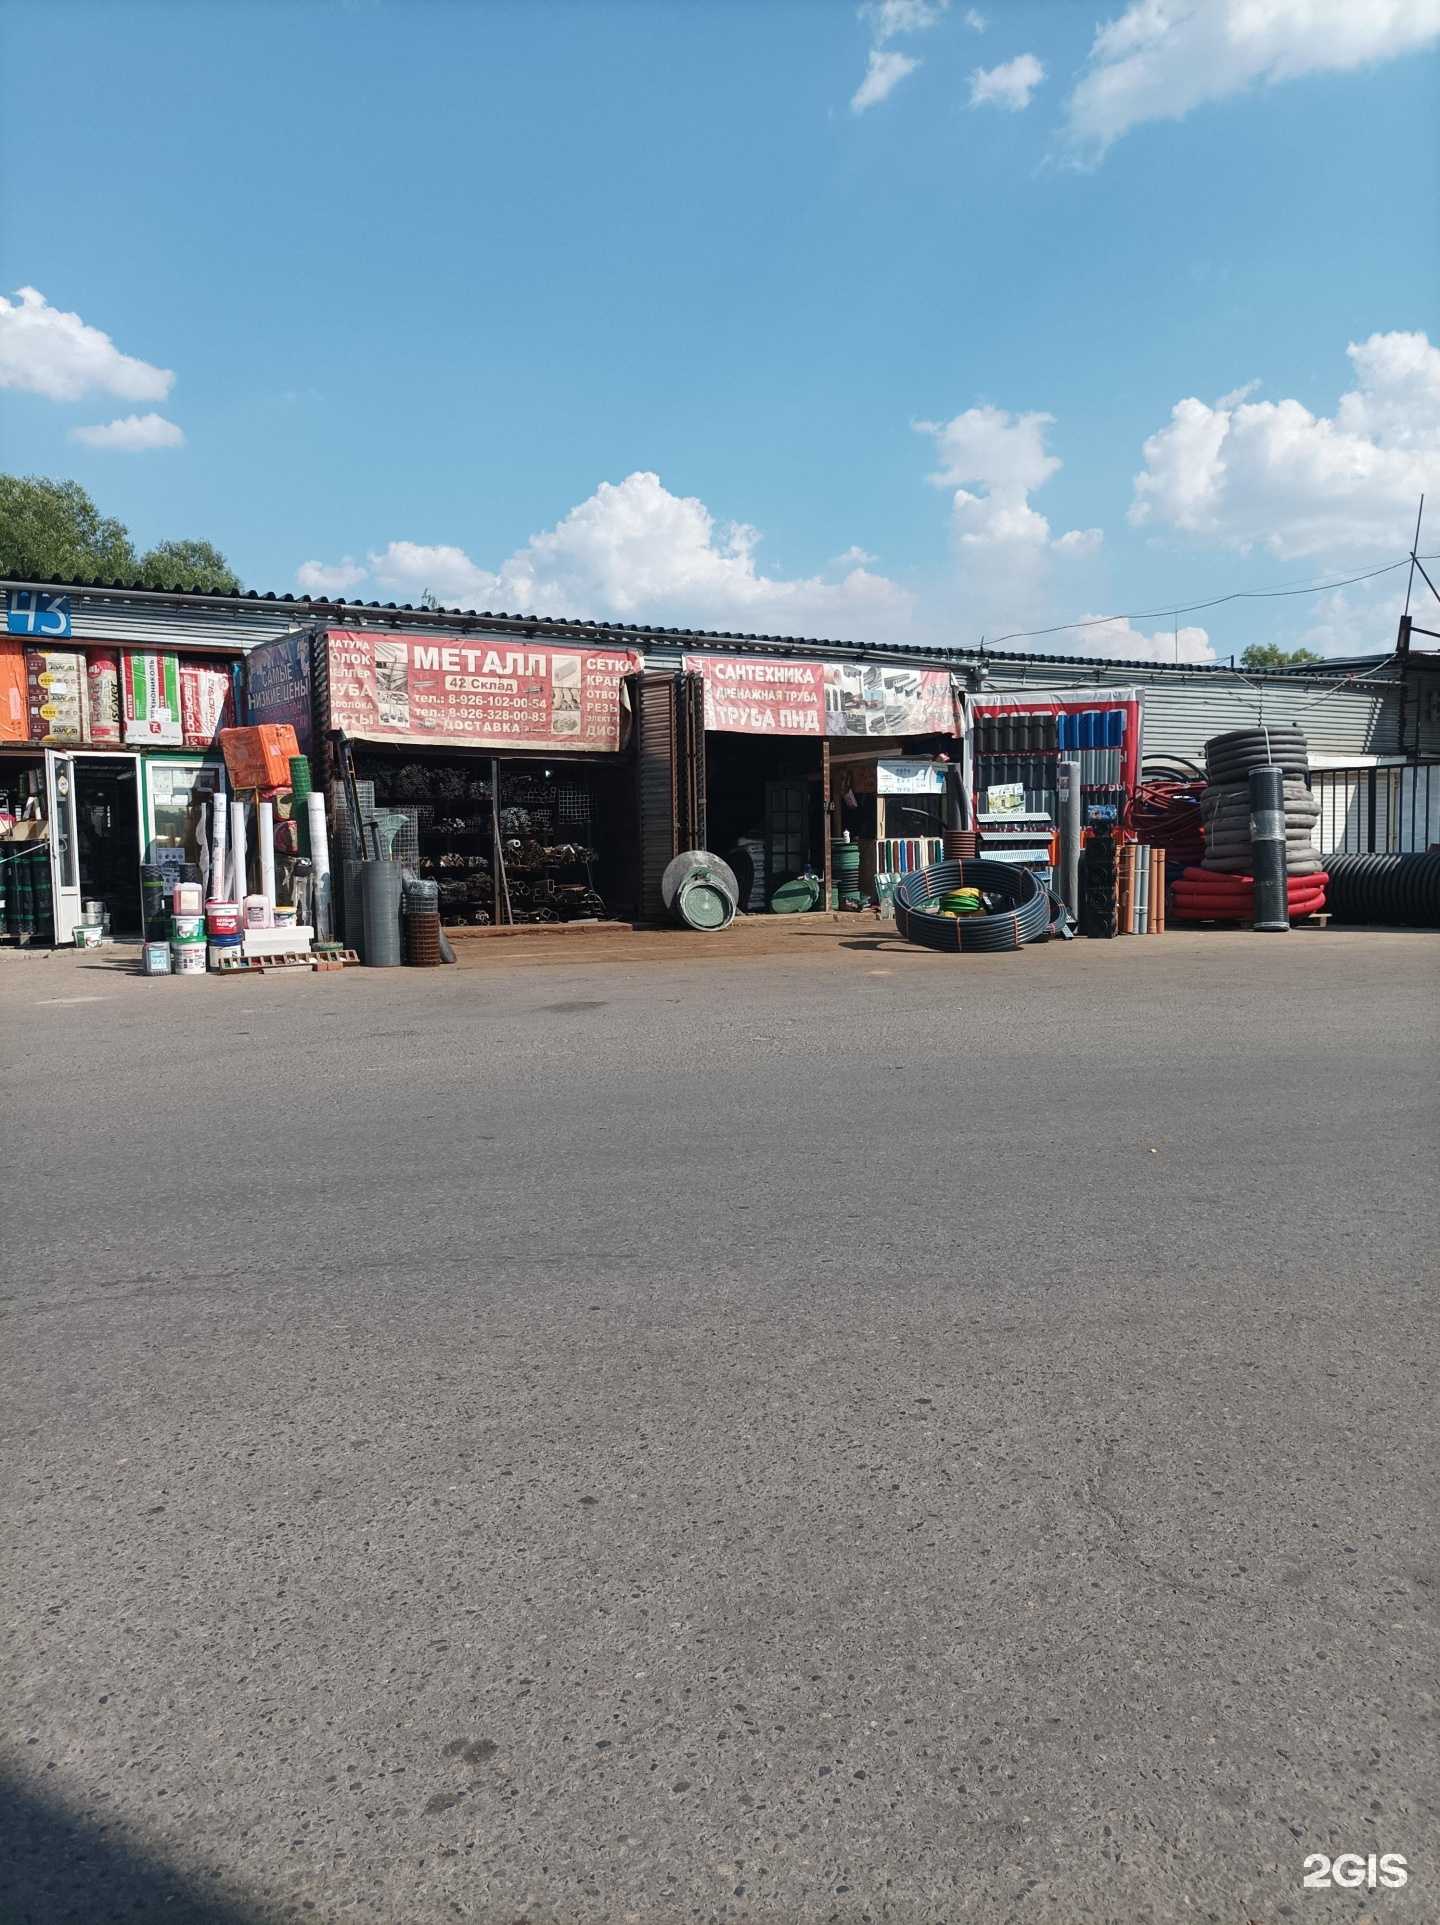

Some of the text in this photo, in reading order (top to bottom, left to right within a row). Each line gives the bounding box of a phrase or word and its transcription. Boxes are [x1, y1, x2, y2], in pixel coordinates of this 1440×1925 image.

[413, 646, 547, 677] МЕТАЛЛ
[262, 663, 293, 687] САМЫЕ
[715, 663, 816, 684] САНТЕХНИКА
[248, 671, 311, 710] НИЗКИЕ ЦЕНЫ
[449, 677, 514, 692] 42 Склад
[448, 694, 547, 709] 8-926-102-00-54
[717, 687, 818, 703] ДРЕНАЖНАЯ ТРУБА
[448, 708, 547, 722] 8-926-328-00-83
[717, 706, 820, 732] ТРУБА ПНД
[443, 720, 521, 733] ДОСТАВКА
